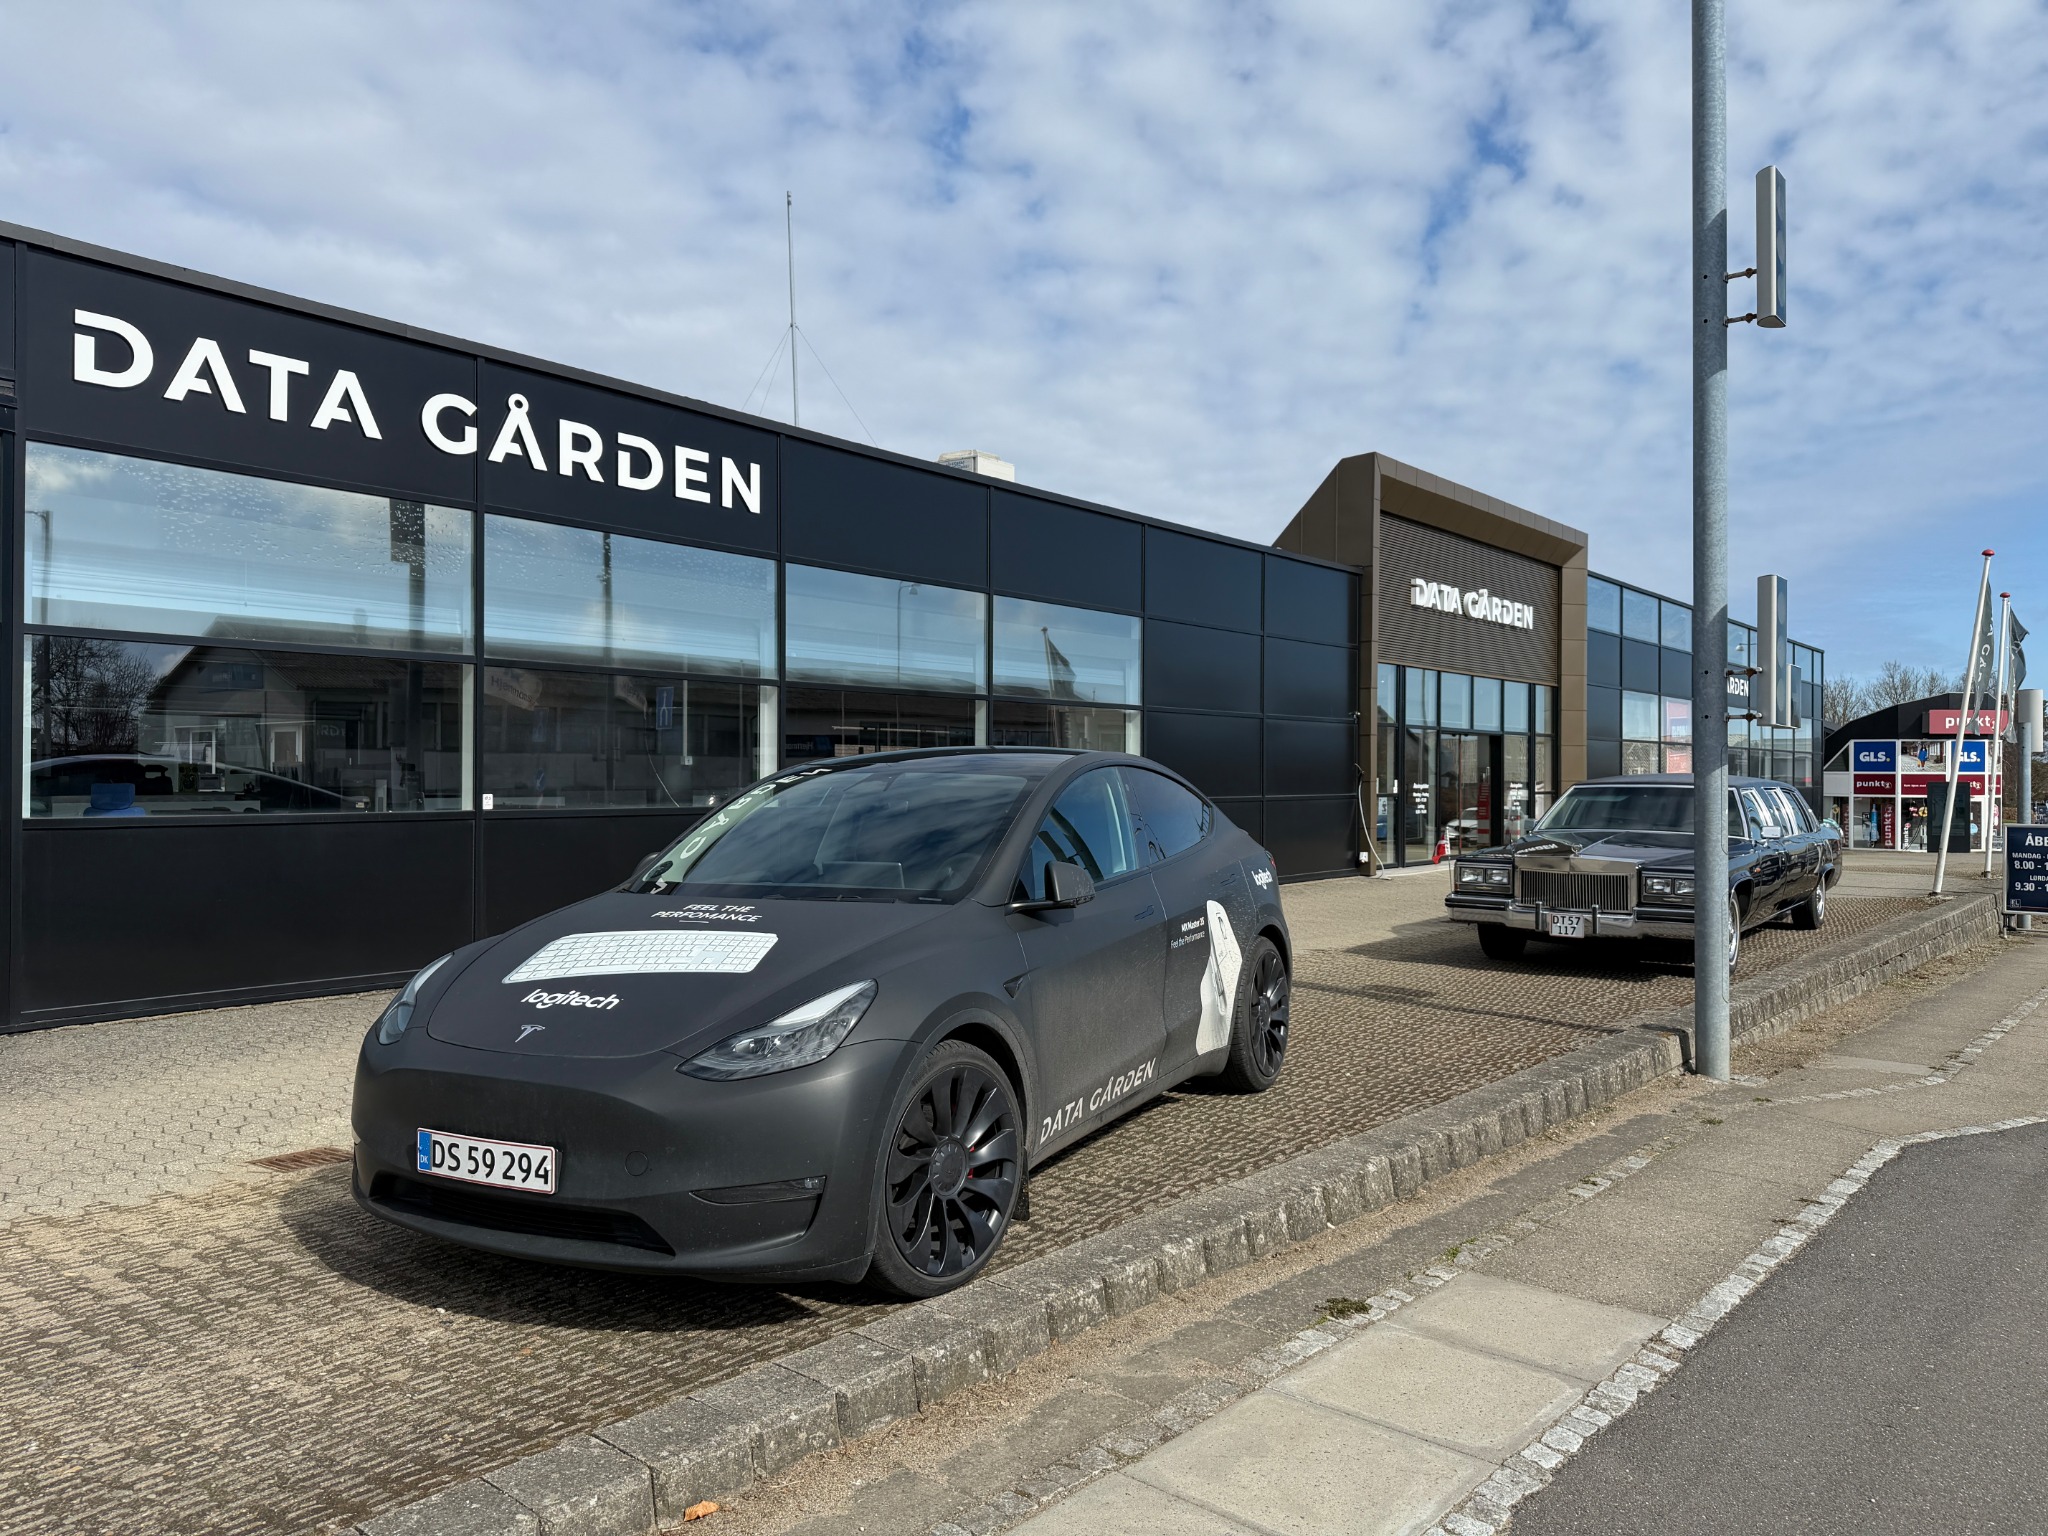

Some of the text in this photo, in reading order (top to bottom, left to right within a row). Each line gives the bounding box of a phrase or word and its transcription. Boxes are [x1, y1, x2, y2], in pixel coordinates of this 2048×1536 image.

[73, 308, 761, 514] DATA GÅRDEN
[1410, 578, 1533, 629] DATA GÅRDEN
[2014, 861, 2035, 870] 8.00
[2015, 882, 2035, 891] 9.30
[651, 911, 762, 922] PERFOMANCE
[1558, 926, 1576, 935] 117
[521, 988, 620, 1010] logitech
[1040, 1057, 1156, 1144] DATA GÅRDEN
[420, 1154, 429, 1164] DK
[432, 1139, 549, 1185] DS 59 294
